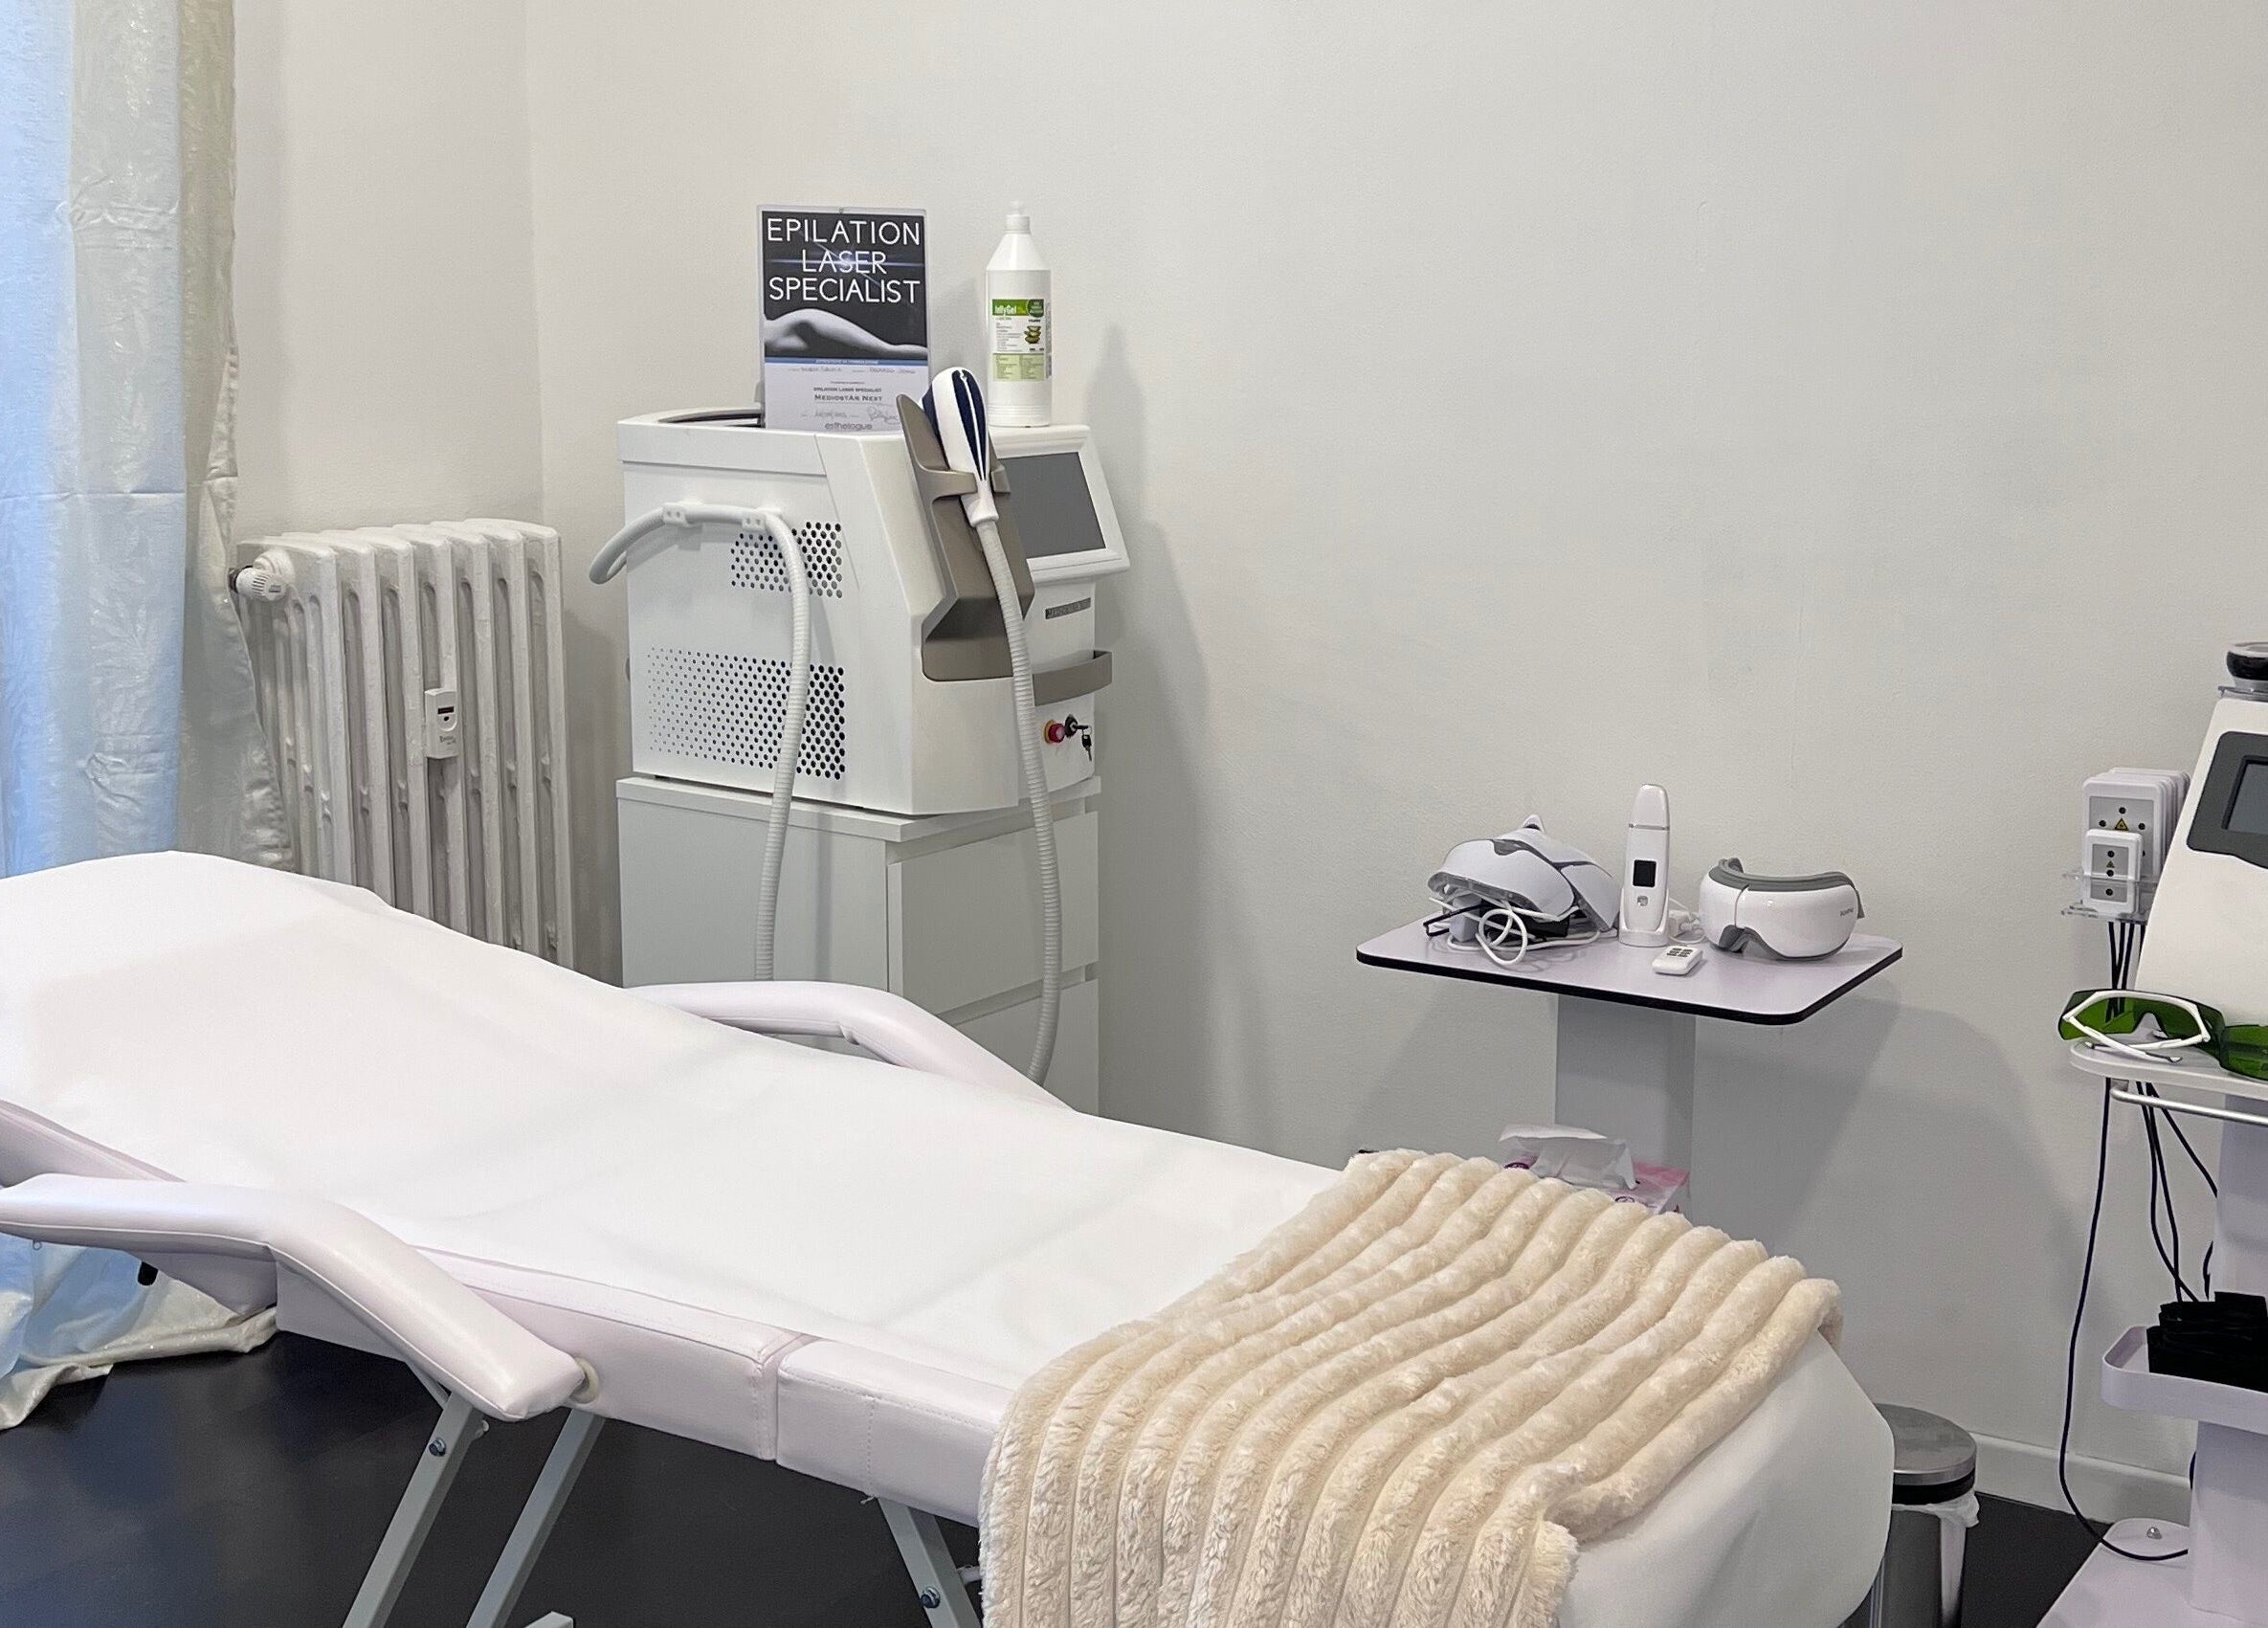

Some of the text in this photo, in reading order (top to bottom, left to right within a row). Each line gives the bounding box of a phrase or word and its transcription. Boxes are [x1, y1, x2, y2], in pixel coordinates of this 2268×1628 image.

[767, 217, 920, 246] EPILATION
[802, 249, 887, 275] LASER
[768, 277, 921, 303] SPECIALIST
